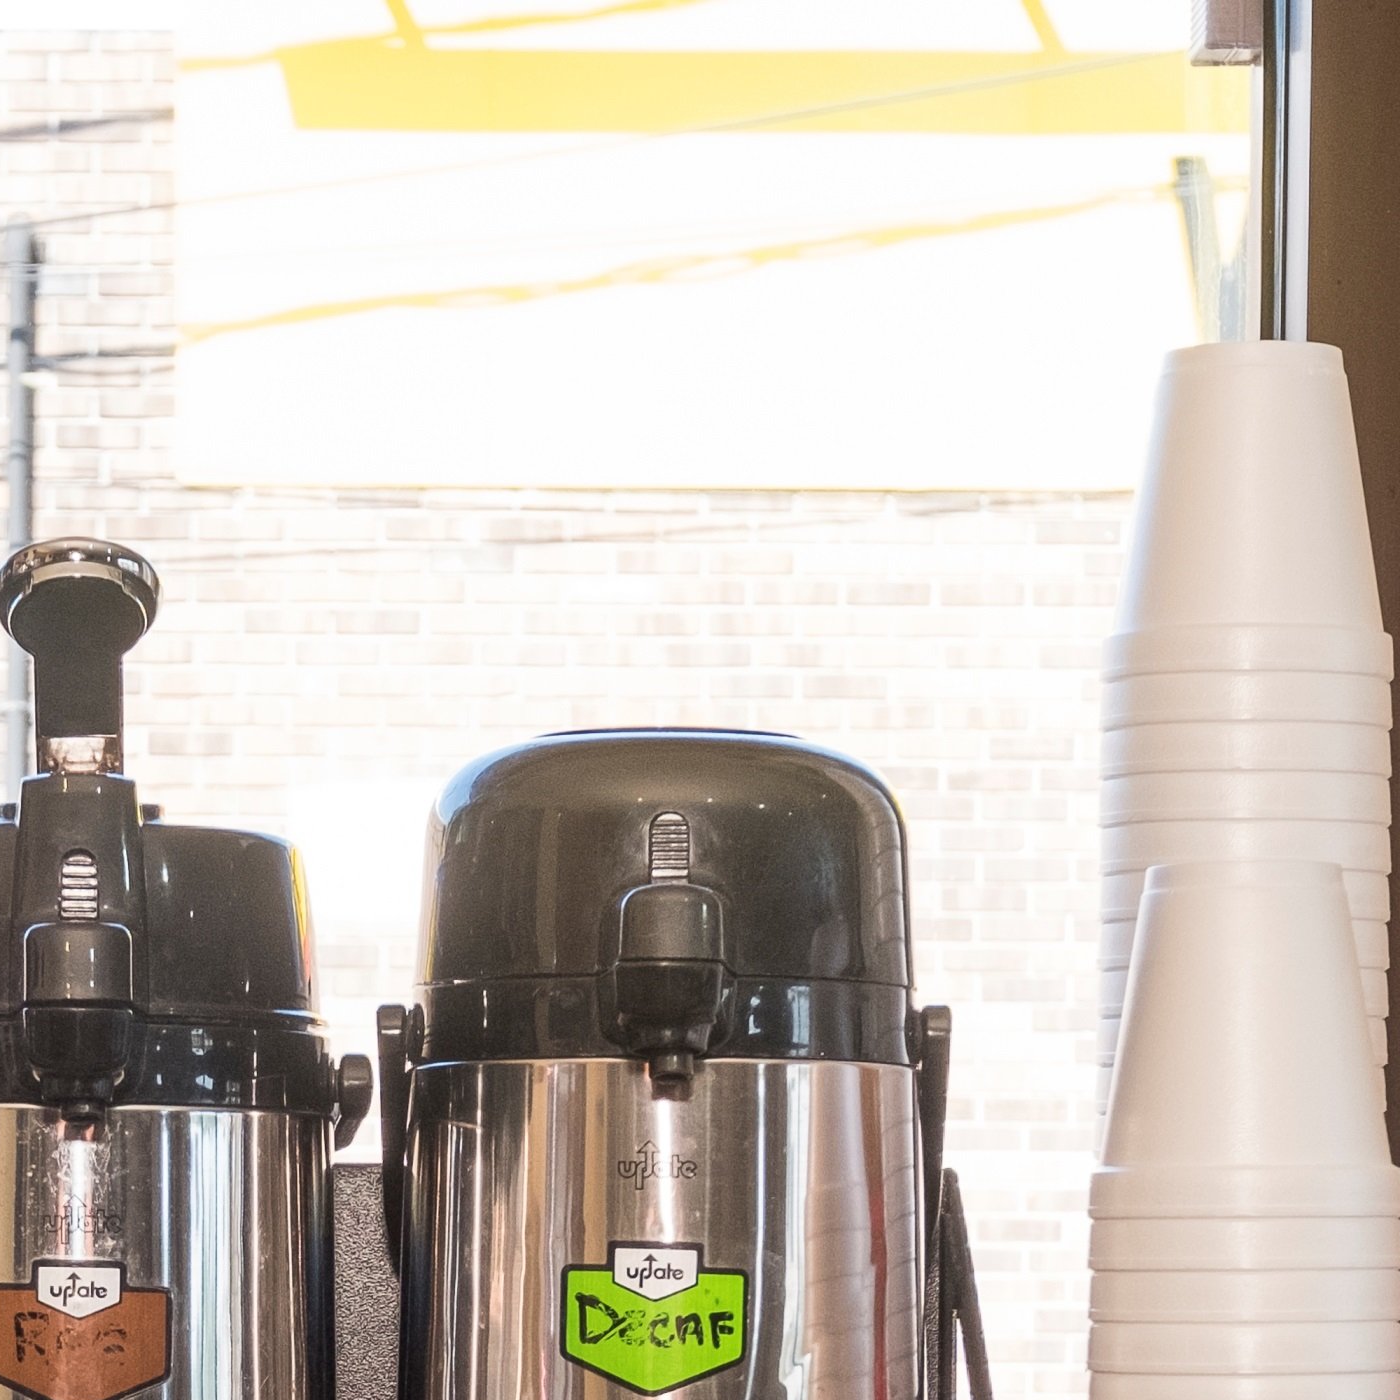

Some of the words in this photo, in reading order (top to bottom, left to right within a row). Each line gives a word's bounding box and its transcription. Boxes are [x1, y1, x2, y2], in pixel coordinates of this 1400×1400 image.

[618, 1140, 697, 1190] update
[627, 1254, 684, 1288] update
[50, 1272, 108, 1307] update
